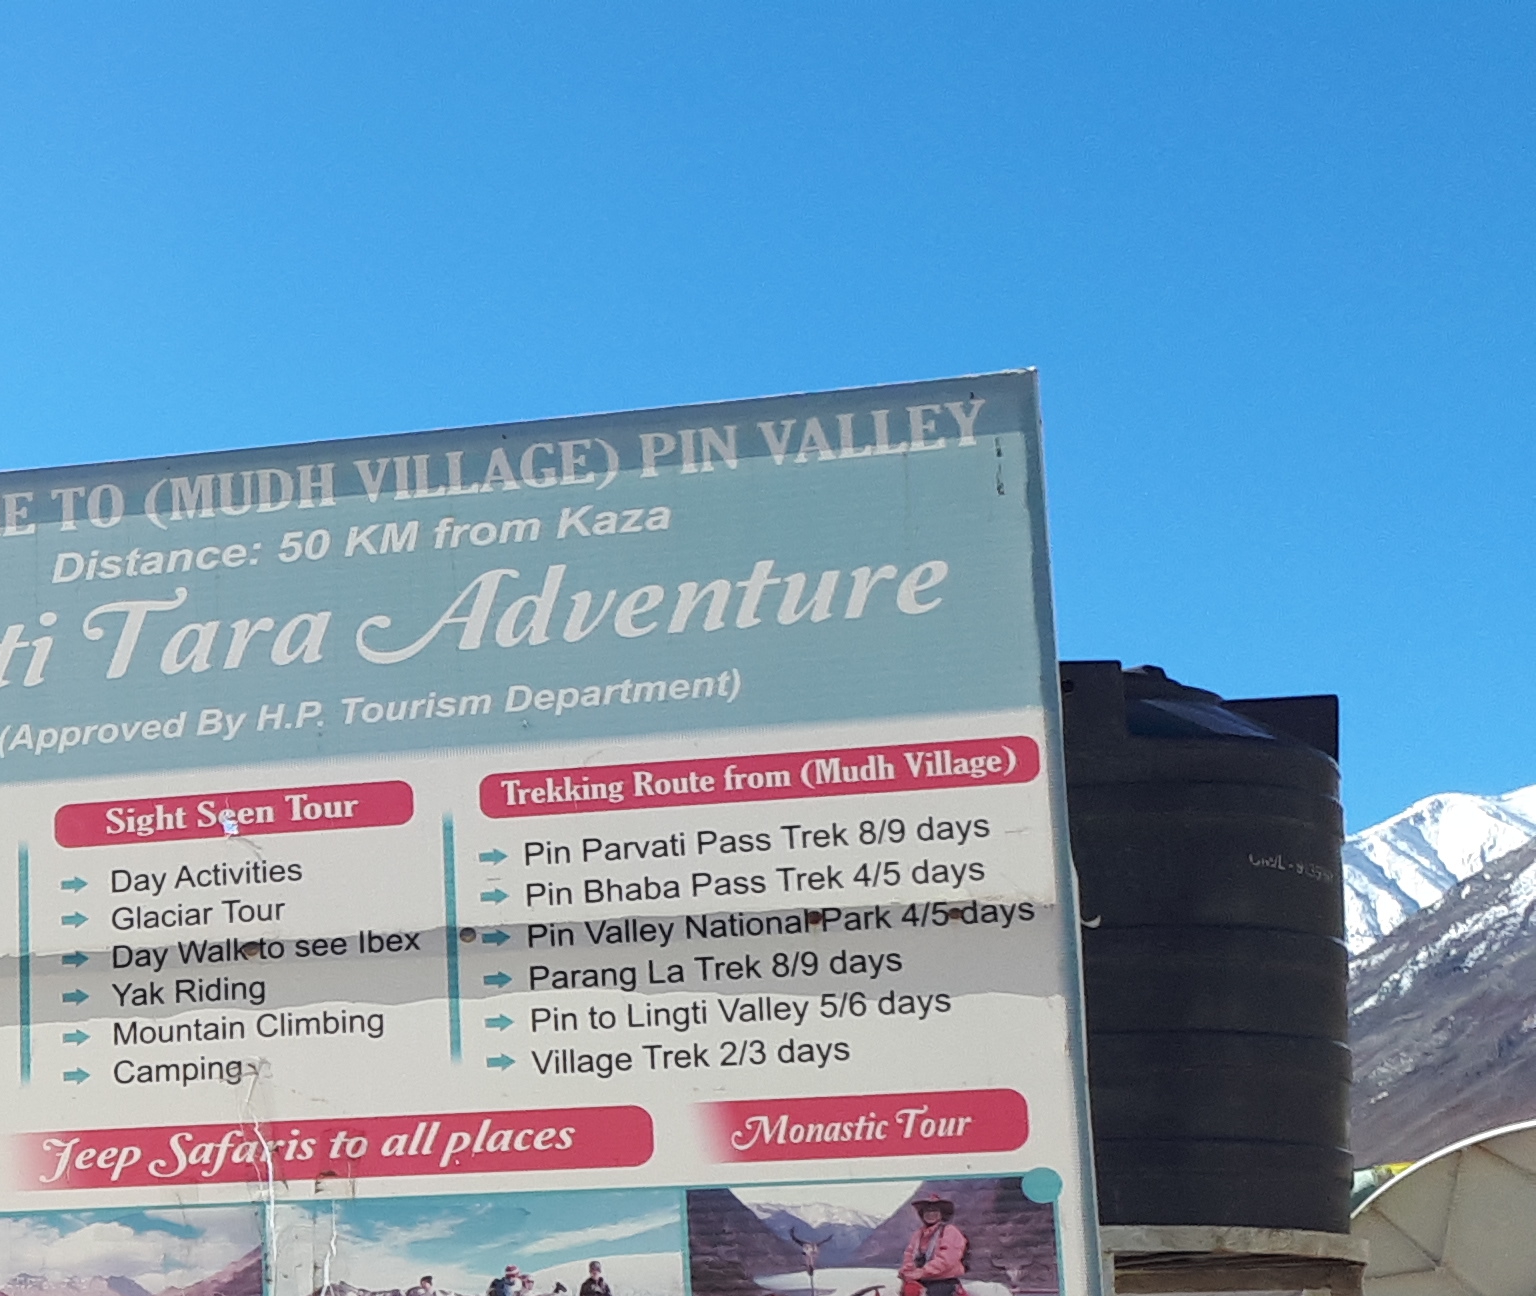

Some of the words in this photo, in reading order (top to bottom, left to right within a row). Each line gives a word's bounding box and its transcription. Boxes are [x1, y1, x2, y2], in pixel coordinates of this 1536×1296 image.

[50, 484, 124, 531] TO
[145, 462, 335, 530] (MUDH
[353, 436, 620, 502] VILLAGE)
[639, 425, 739, 478] PIN
[757, 399, 986, 466] VALLEY
[52, 542, 262, 584] Distance:
[278, 528, 331, 564] 50
[344, 519, 419, 557] KM
[433, 516, 540, 550] from
[556, 504, 671, 539] Kaza
[82, 586, 332, 680] Tara
[354, 559, 949, 665] Adventure
[196, 704, 244, 742] By
[256, 701, 324, 732] H.P.
[341, 694, 492, 727] Tourism
[505, 668, 742, 716] Department)
[501, 775, 625, 807] Trekking
[633, 767, 716, 798] Route
[724, 764, 791, 791] from
[799, 756, 896, 789] (Mudh
[904, 746, 1017, 780] Village)
[523, 840, 571, 866] Pin
[582, 832, 686, 863] Parvati
[697, 829, 772, 856] Pass
[780, 822, 849, 850] Trek
[858, 818, 907, 846] 8/9
[916, 816, 990, 845] days
[111, 870, 167, 897] Day
[174, 861, 303, 889] Activities
[111, 905, 214, 930] Glaciar
[222, 900, 285, 924] Tour
[112, 981, 165, 1007] Yak
[175, 977, 266, 1005] Riding
[531, 1005, 579, 1033] Pin
[589, 1005, 617, 1030] to
[627, 999, 708, 1033] Lingti
[717, 994, 809, 1028] Valley
[820, 992, 867, 1020] 5/6
[878, 989, 952, 1019] days
[113, 1014, 245, 1046] Mountain
[256, 1011, 385, 1038] Climbing
[113, 1057, 243, 1086] Camping
[531, 1046, 633, 1080] Village
[642, 1043, 710, 1070] Trek
[720, 1040, 767, 1067] 2/3
[776, 1037, 851, 1067] days
[731, 1112, 888, 1150] Monastic
[895, 1104, 972, 1138] Tour
[39, 1137, 142, 1184] Jeep
[147, 1129, 317, 1179] Safaris
[330, 1130, 367, 1161] to
[380, 1121, 441, 1158] all
[439, 1119, 577, 1167] places
